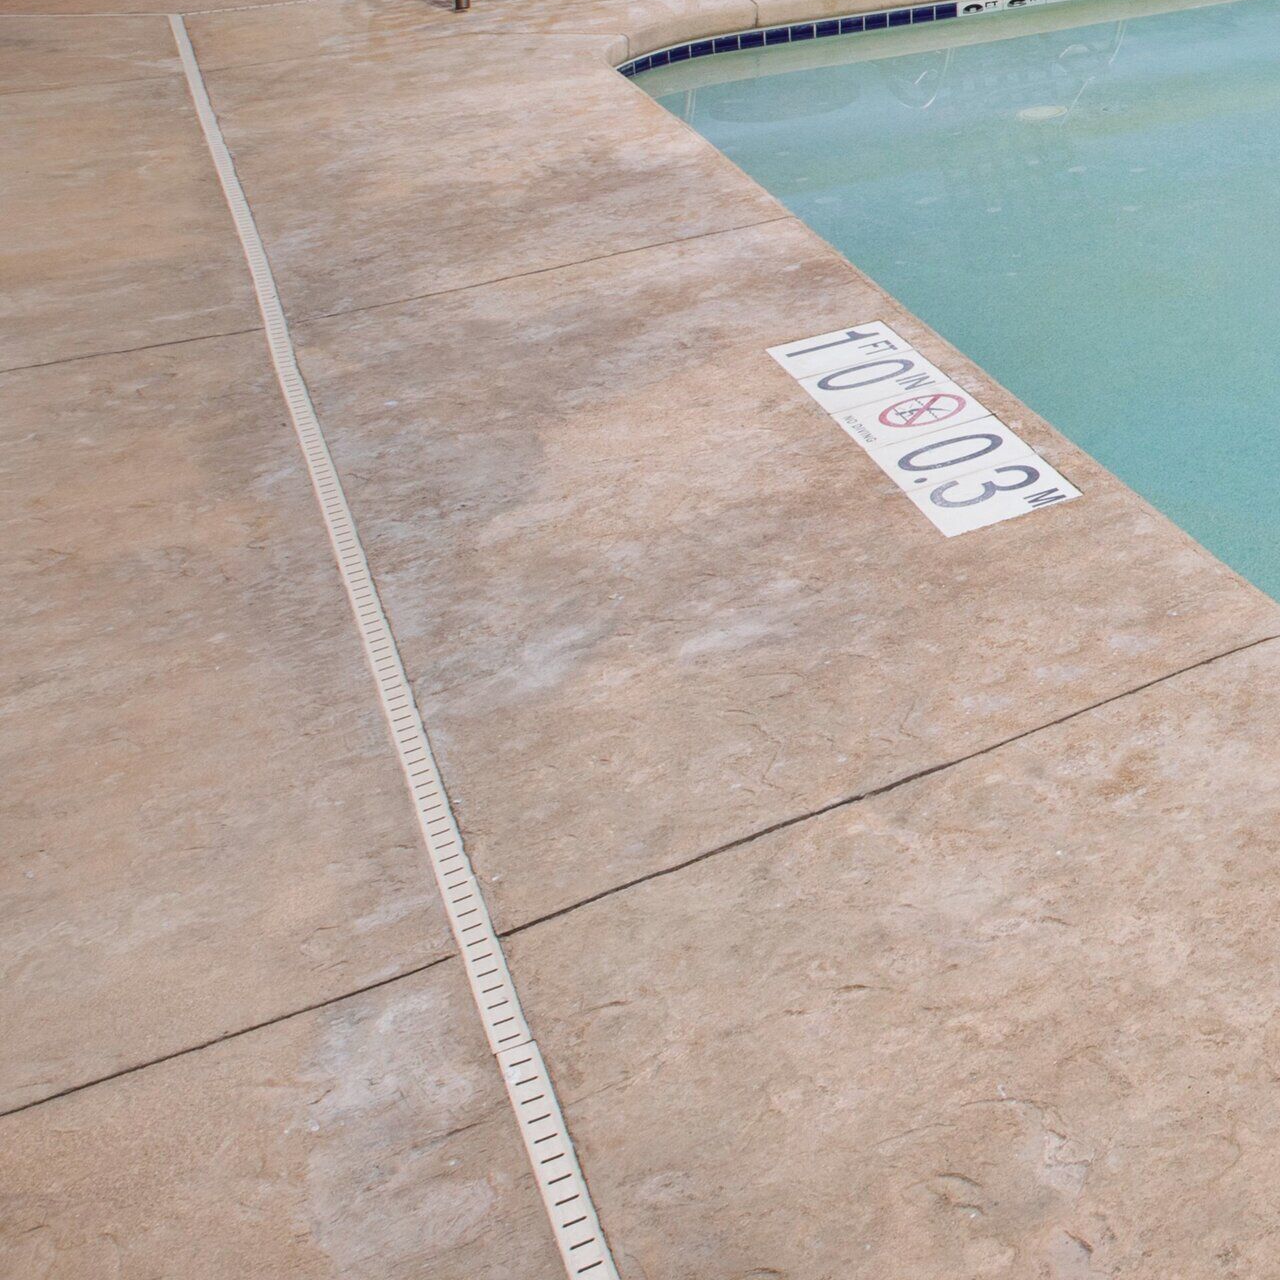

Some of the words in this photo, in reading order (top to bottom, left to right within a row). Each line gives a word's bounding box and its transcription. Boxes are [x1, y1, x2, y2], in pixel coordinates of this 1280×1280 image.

[786, 330, 880, 358] 1
[858, 339, 898, 355] FT
[816, 358, 915, 391] 0
[895, 372, 936, 391] IN
[1023, 487, 1067, 508] M
